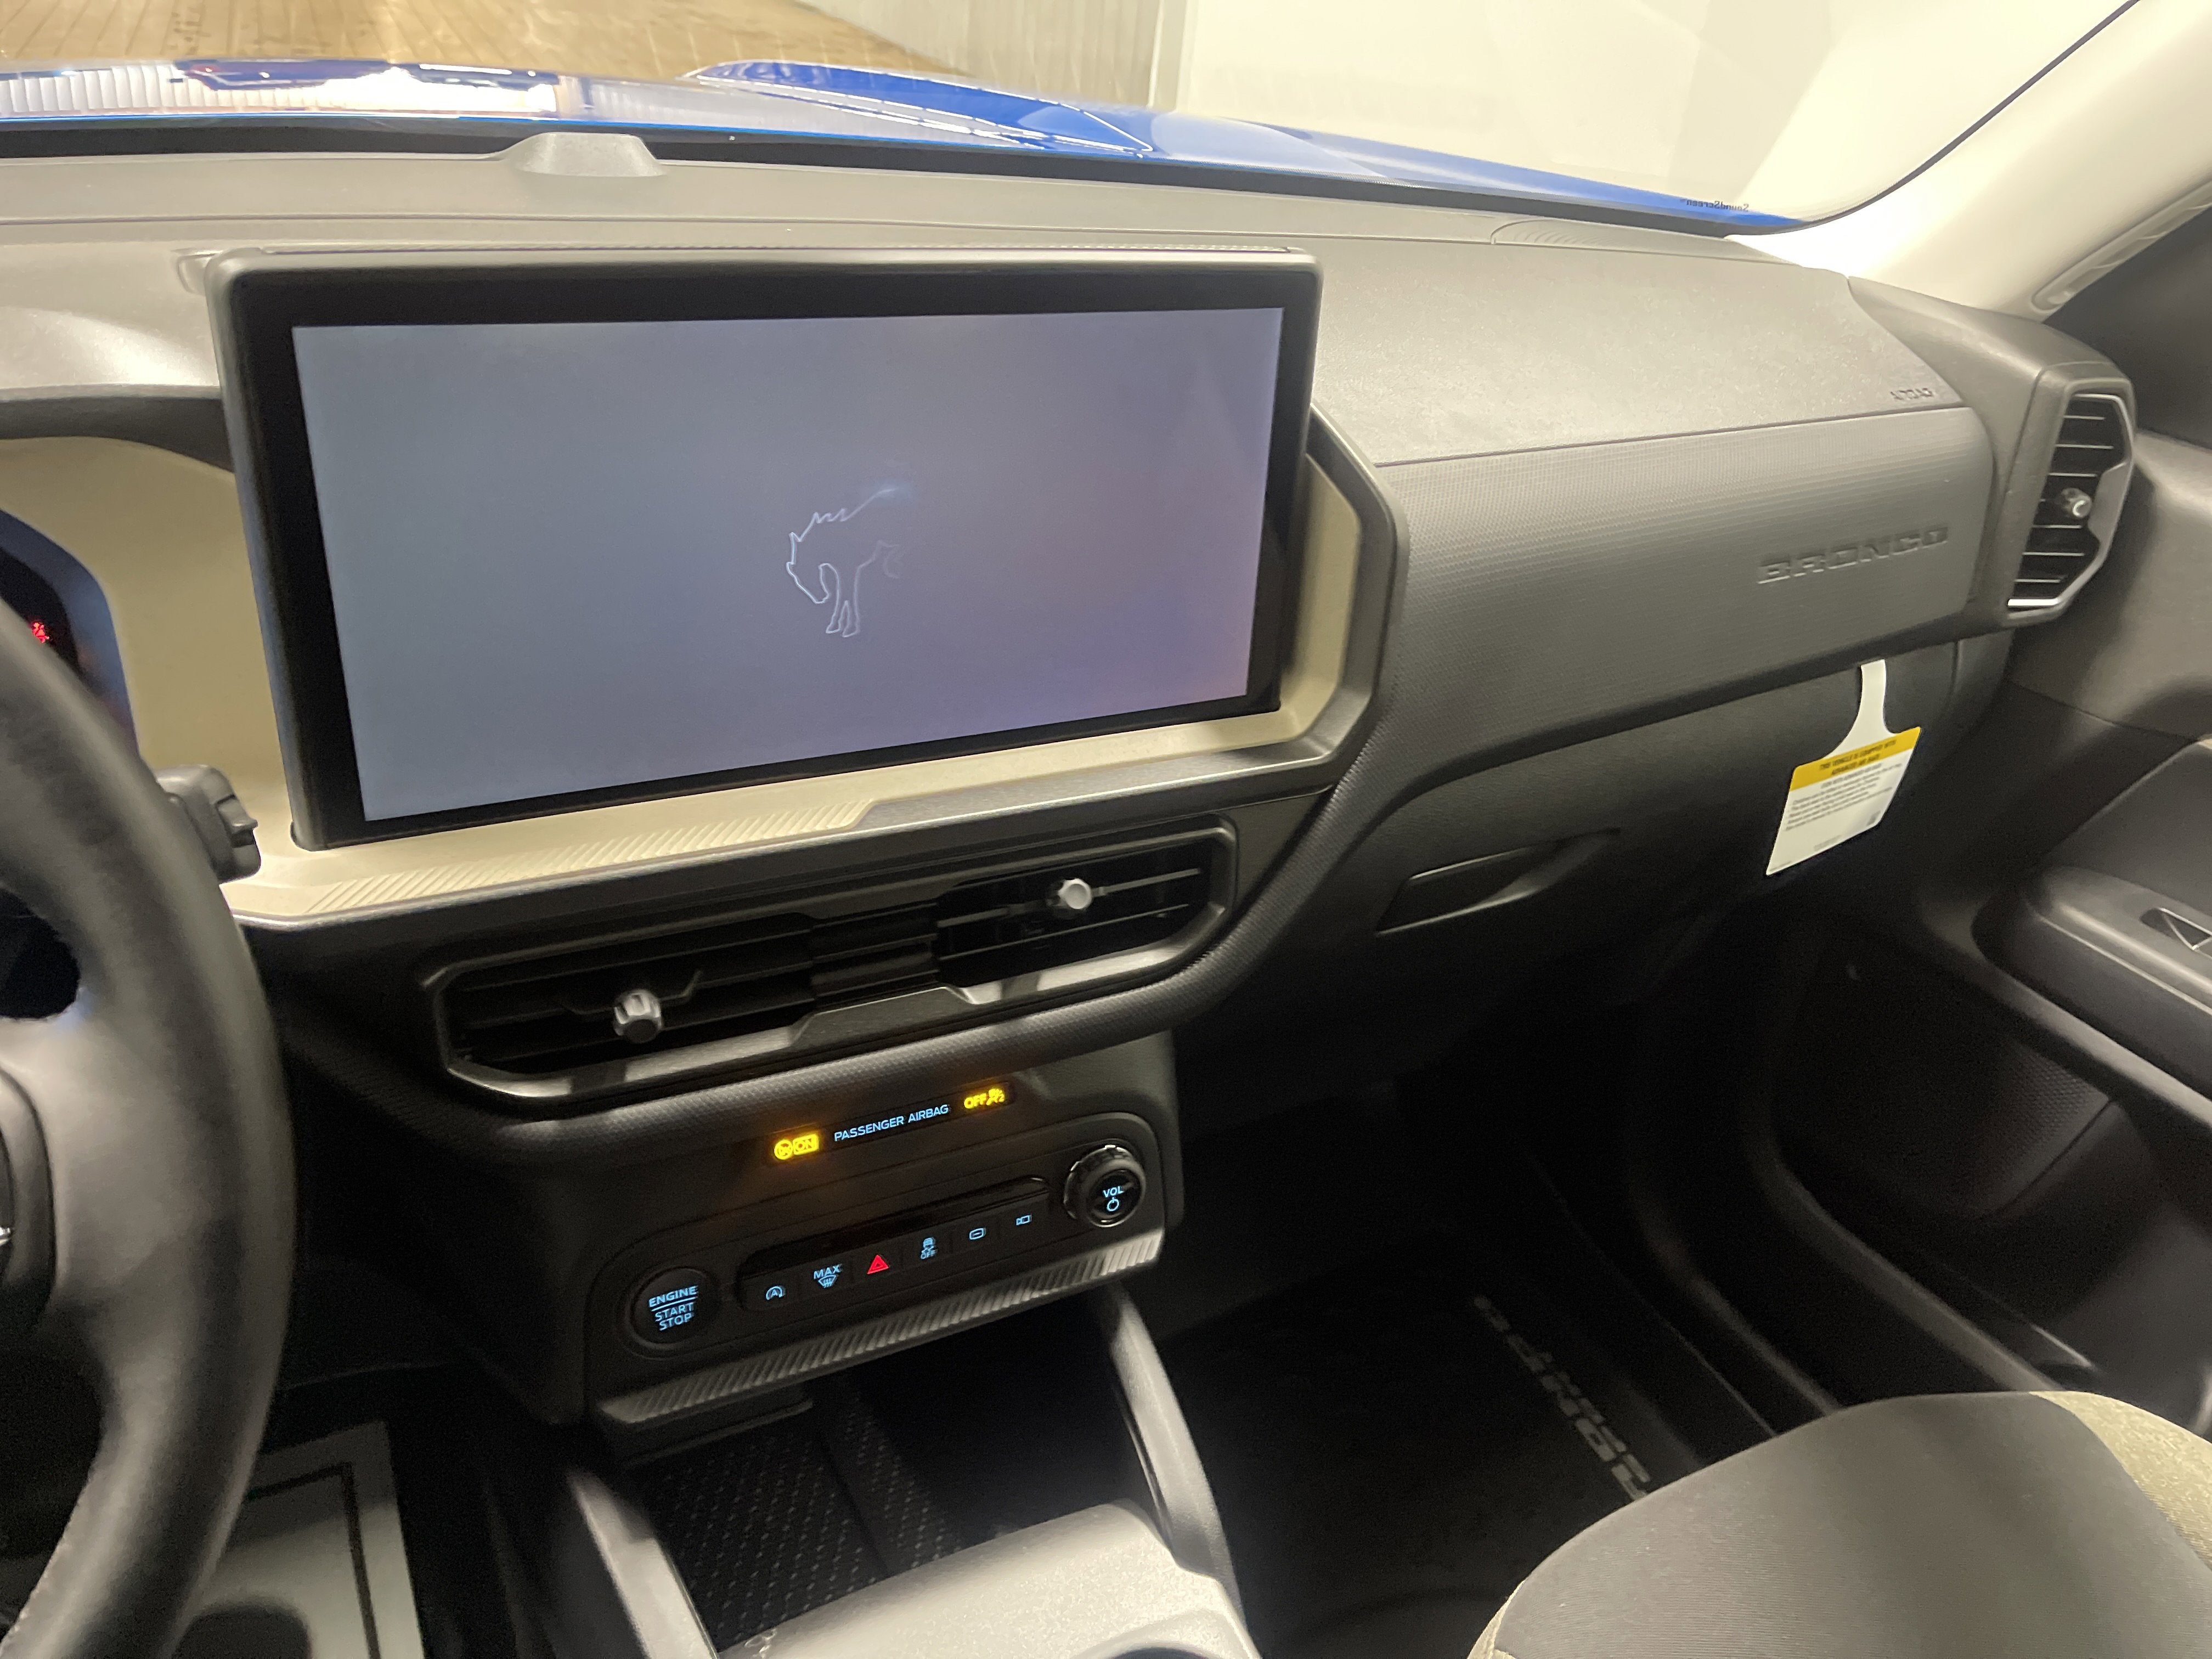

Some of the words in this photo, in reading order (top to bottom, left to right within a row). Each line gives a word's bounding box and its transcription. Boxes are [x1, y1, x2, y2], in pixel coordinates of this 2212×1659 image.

[1757, 526, 1948, 584] BRONCO
[964, 1092, 987, 1109] OFF
[834, 1115, 904, 1142] PASSENGER
[908, 1104, 949, 1123] AIRBAG
[796, 1136, 816, 1152] ON
[1102, 1186, 1124, 1198] VOL
[920, 1248, 938, 1260] OFF
[814, 1263, 842, 1279] MAX
[648, 1285, 698, 1308] ENGINE
[655, 1301, 695, 1322] START
[659, 1312, 695, 1331] STOP
